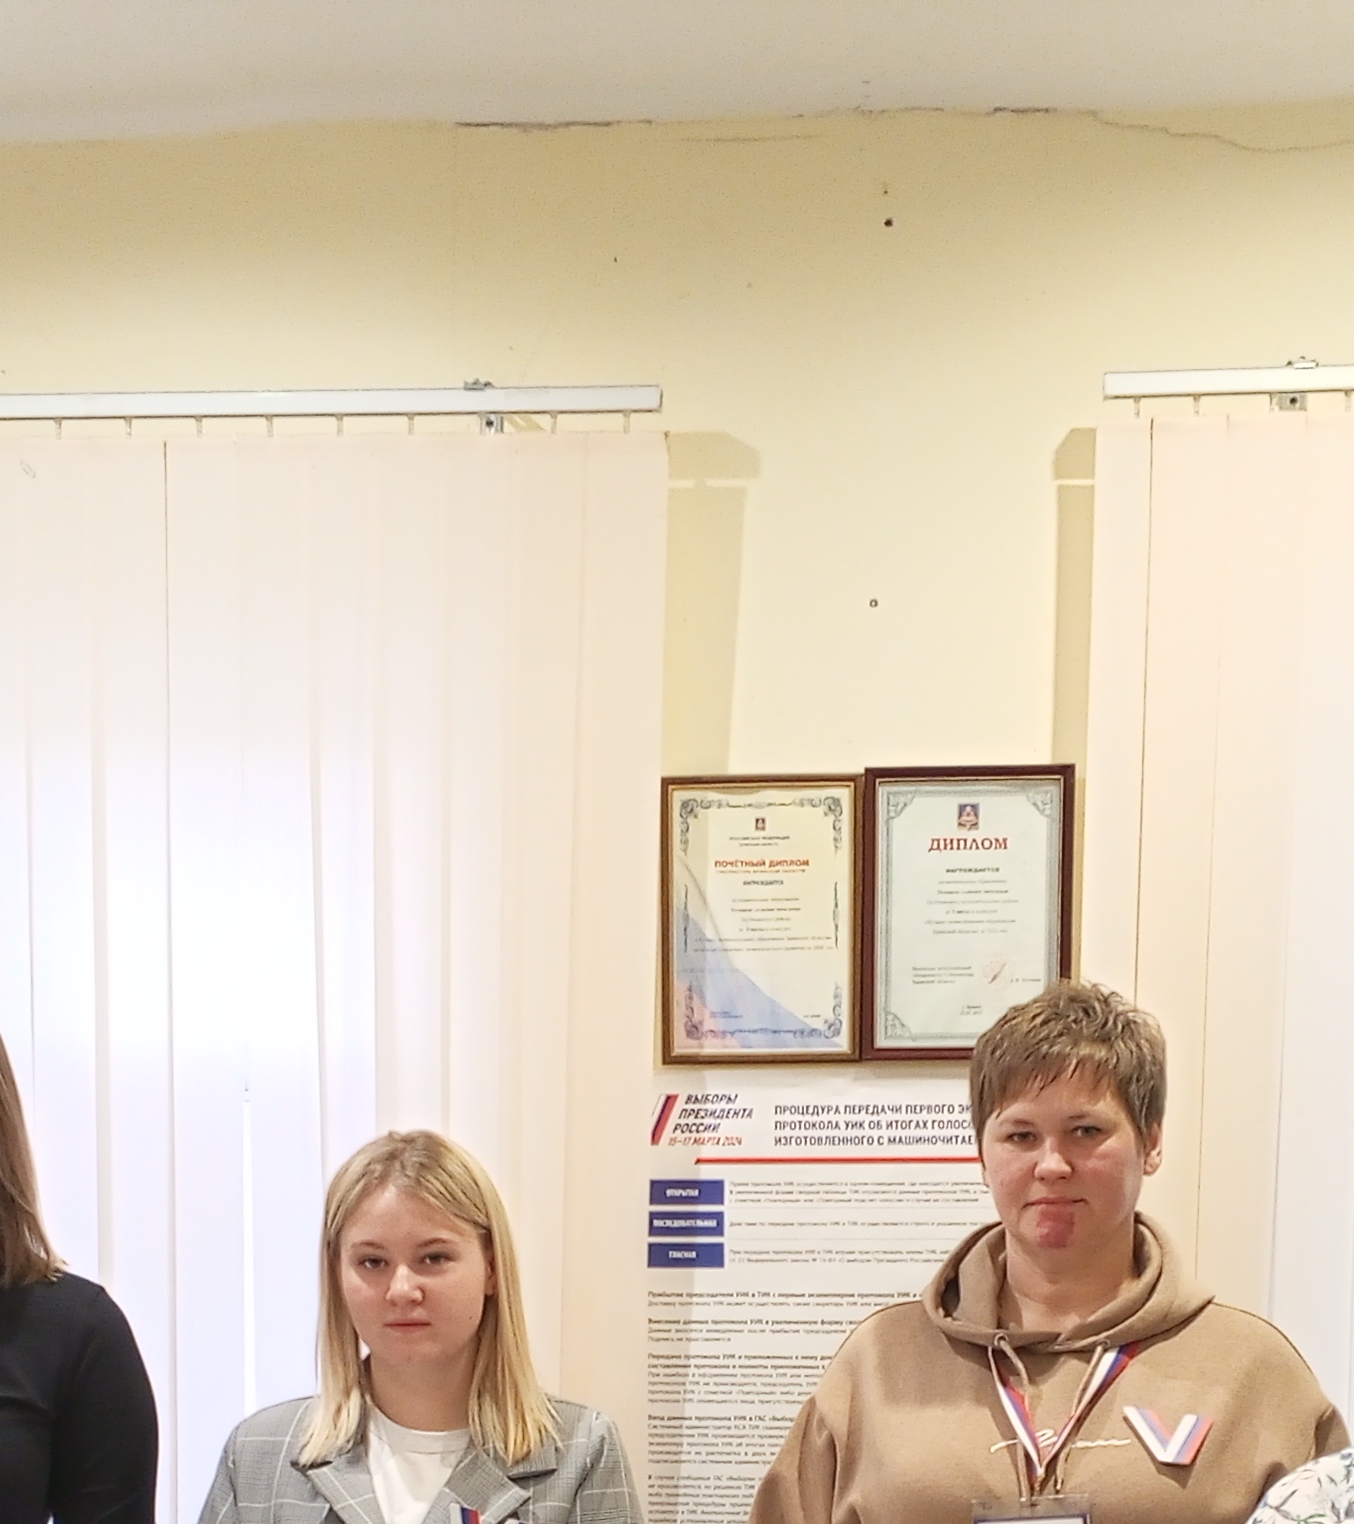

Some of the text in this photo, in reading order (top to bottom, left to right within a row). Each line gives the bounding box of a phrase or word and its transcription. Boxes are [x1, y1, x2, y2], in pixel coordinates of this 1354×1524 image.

[928, 838, 1008, 852] ДИПЛОМ
[769, 859, 809, 867] ДИПЛОМ
[685, 1094, 738, 1105] ВЫБОРЫ
[678, 1108, 754, 1120] ПРЕЗИДЕНТА
[774, 1104, 840, 1117] ПРОЦЕДУРА
[844, 1104, 902, 1117] ПЕРЕДАЧИ
[905, 1104, 955, 1115] ПЕРВОГО
[672, 1123, 721, 1134] РОССИИ
[774, 1120, 840, 1131] ПРОТОКОЛА
[844, 1120, 865, 1131] УИК
[868, 1120, 882, 1130] ОБ
[886, 1119, 929, 1130] ИТОГАХ
[774, 1135, 874, 1146] ИЗГОТОВЛЕННОГО
[877, 1135, 884, 1146] С
